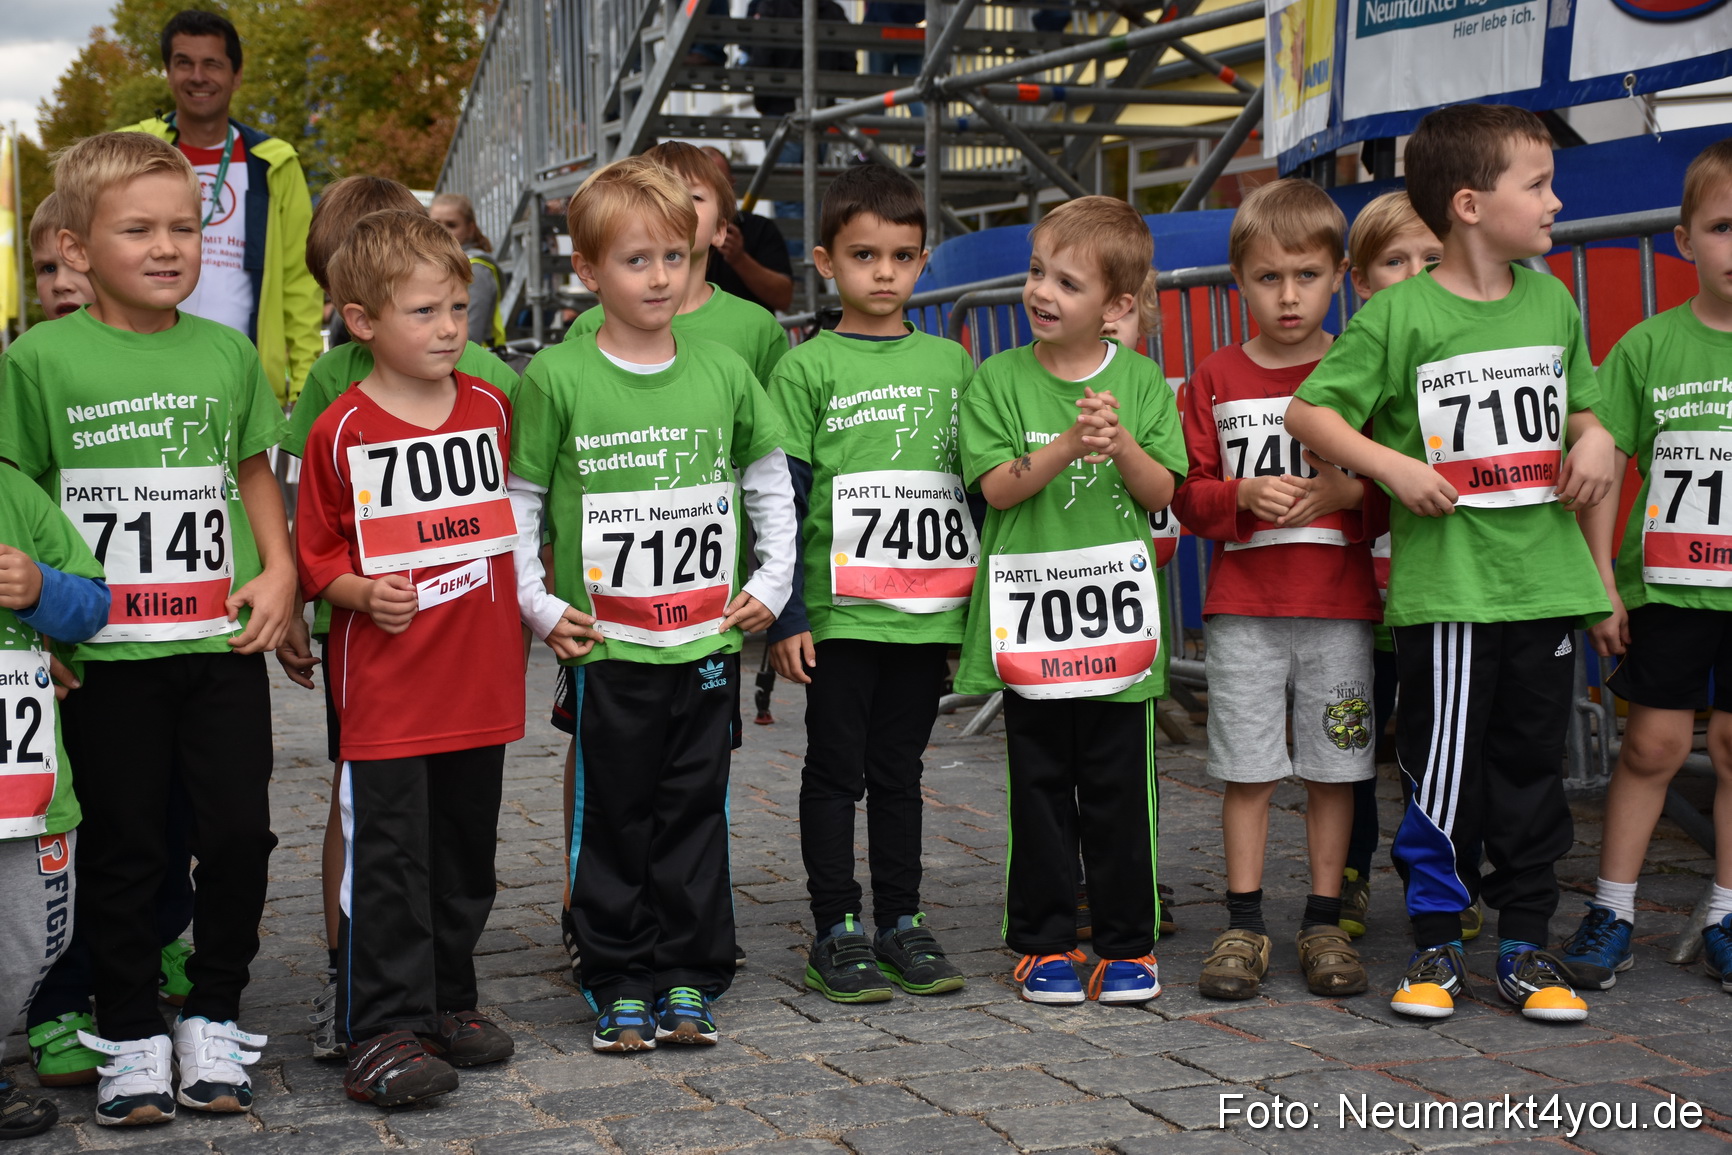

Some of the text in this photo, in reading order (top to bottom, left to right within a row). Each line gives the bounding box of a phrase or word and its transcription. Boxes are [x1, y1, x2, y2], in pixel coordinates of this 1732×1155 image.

[1453, 6, 1536, 39] Hier lebe ich.
[1422, 363, 1550, 393] PARTL Neumarkt
[66, 392, 198, 424] Neumarkter
[828, 384, 922, 411] Neumarkter
[826, 404, 906, 432] Stadtlauf
[1218, 415, 1258, 433] PARTL
[1439, 385, 1560, 452] 7106
[72, 417, 174, 450] Stadtlauf
[575, 425, 688, 451] Neumarkter
[578, 448, 668, 476] Stadtlauf
[1434, 452, 1442, 461] 2
[1655, 447, 1704, 461] PARTL
[368, 433, 500, 507] 7000
[1468, 463, 1553, 488] Johannes
[66, 485, 217, 502] PARTL Neumarkt
[837, 485, 952, 500] PARTL Neumarkt
[363, 507, 369, 518] 2
[588, 503, 714, 524] PARTL Neumarkt
[417, 516, 481, 543] Lukas
[852, 508, 969, 560] 7408
[1649, 521, 1655, 530] 2
[82, 509, 226, 574] 7143
[602, 523, 723, 588] 7126
[970, 556, 976, 565] K
[720, 571, 726, 582] K
[994, 560, 1124, 583] PARTL Neumarkt
[439, 572, 471, 595] DEHN
[592, 584, 599, 593] 2
[862, 574, 929, 593] MAXI
[125, 593, 198, 617] Kilian
[653, 602, 688, 625] Tim
[1009, 580, 1144, 645] 7096
[1146, 627, 1152, 637] K
[999, 641, 1005, 650] 2
[1041, 655, 1117, 678] Marlon
[701, 678, 727, 690] adidas
[45, 758, 51, 770] K
[44, 1025, 67, 1040] LICO
[230, 1030, 251, 1041] LICO
[95, 1041, 121, 1051] LICO
